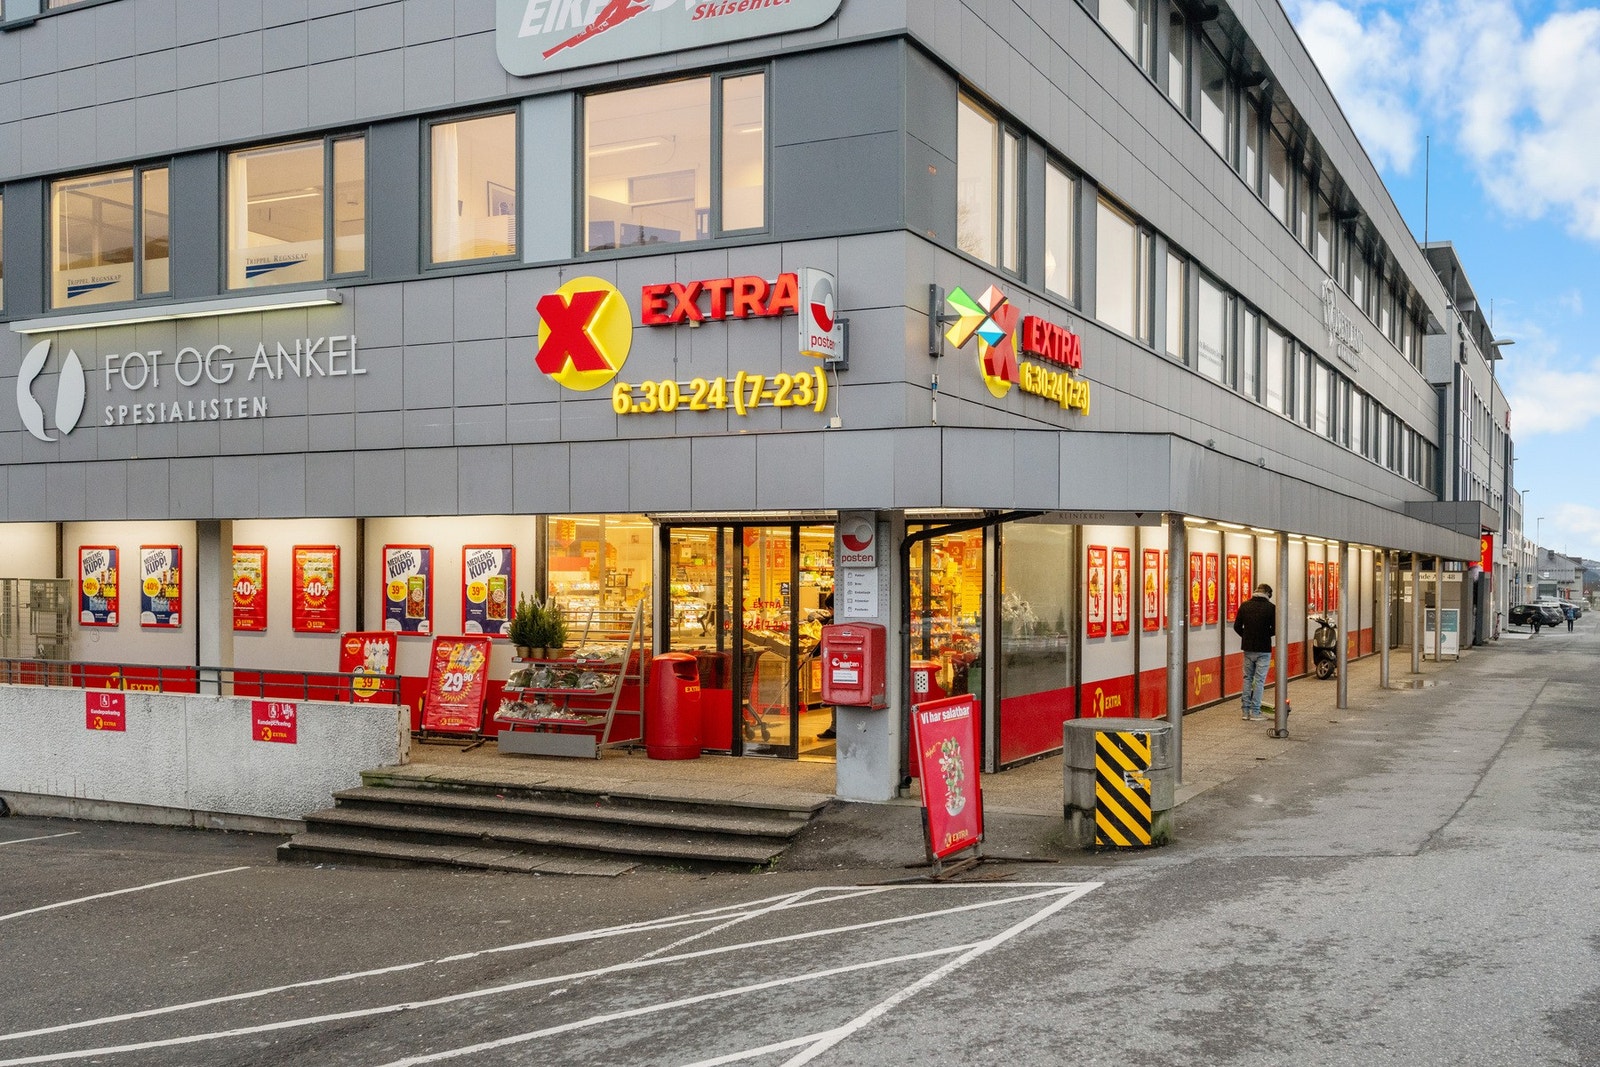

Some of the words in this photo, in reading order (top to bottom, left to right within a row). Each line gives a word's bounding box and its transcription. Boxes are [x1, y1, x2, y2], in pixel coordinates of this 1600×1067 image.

[245, 256, 271, 265] TRIPPEL
[273, 252, 309, 262] REGNSKAP
[67, 278, 90, 286] TRIPPEL
[91, 274, 122, 283] REGNSKAP
[642, 273, 798, 325] EXTRA
[1023, 315, 1083, 369] EXTRA
[105, 351, 163, 391] FOT
[175, 344, 235, 387] OG
[248, 334, 367, 381] ANKEL
[612, 375, 728, 414] 6.30-24
[104, 396, 269, 426] SPESIALISTEN
[84, 556, 106, 576] KUPP!
[145, 556, 168, 576] KUPP!
[841, 554, 874, 564] posten
[389, 558, 416, 579] KUPP!
[469, 557, 498, 580] KUPP!
[233, 581, 257, 596] -40%
[303, 582, 330, 597] -40%
[753, 601, 782, 609] EXTRA
[130, 683, 160, 692] EXTRA
[361, 677, 373, 688] 39
[1201, 674, 1213, 686] EXTRA
[1105, 694, 1122, 710] EXTRA
[90, 709, 121, 717] Kundeparkering
[921, 712, 929, 725] Vi
[929, 710, 941, 723] har
[942, 706, 970, 720] salatbar
[952, 829, 969, 842] EXTRA
